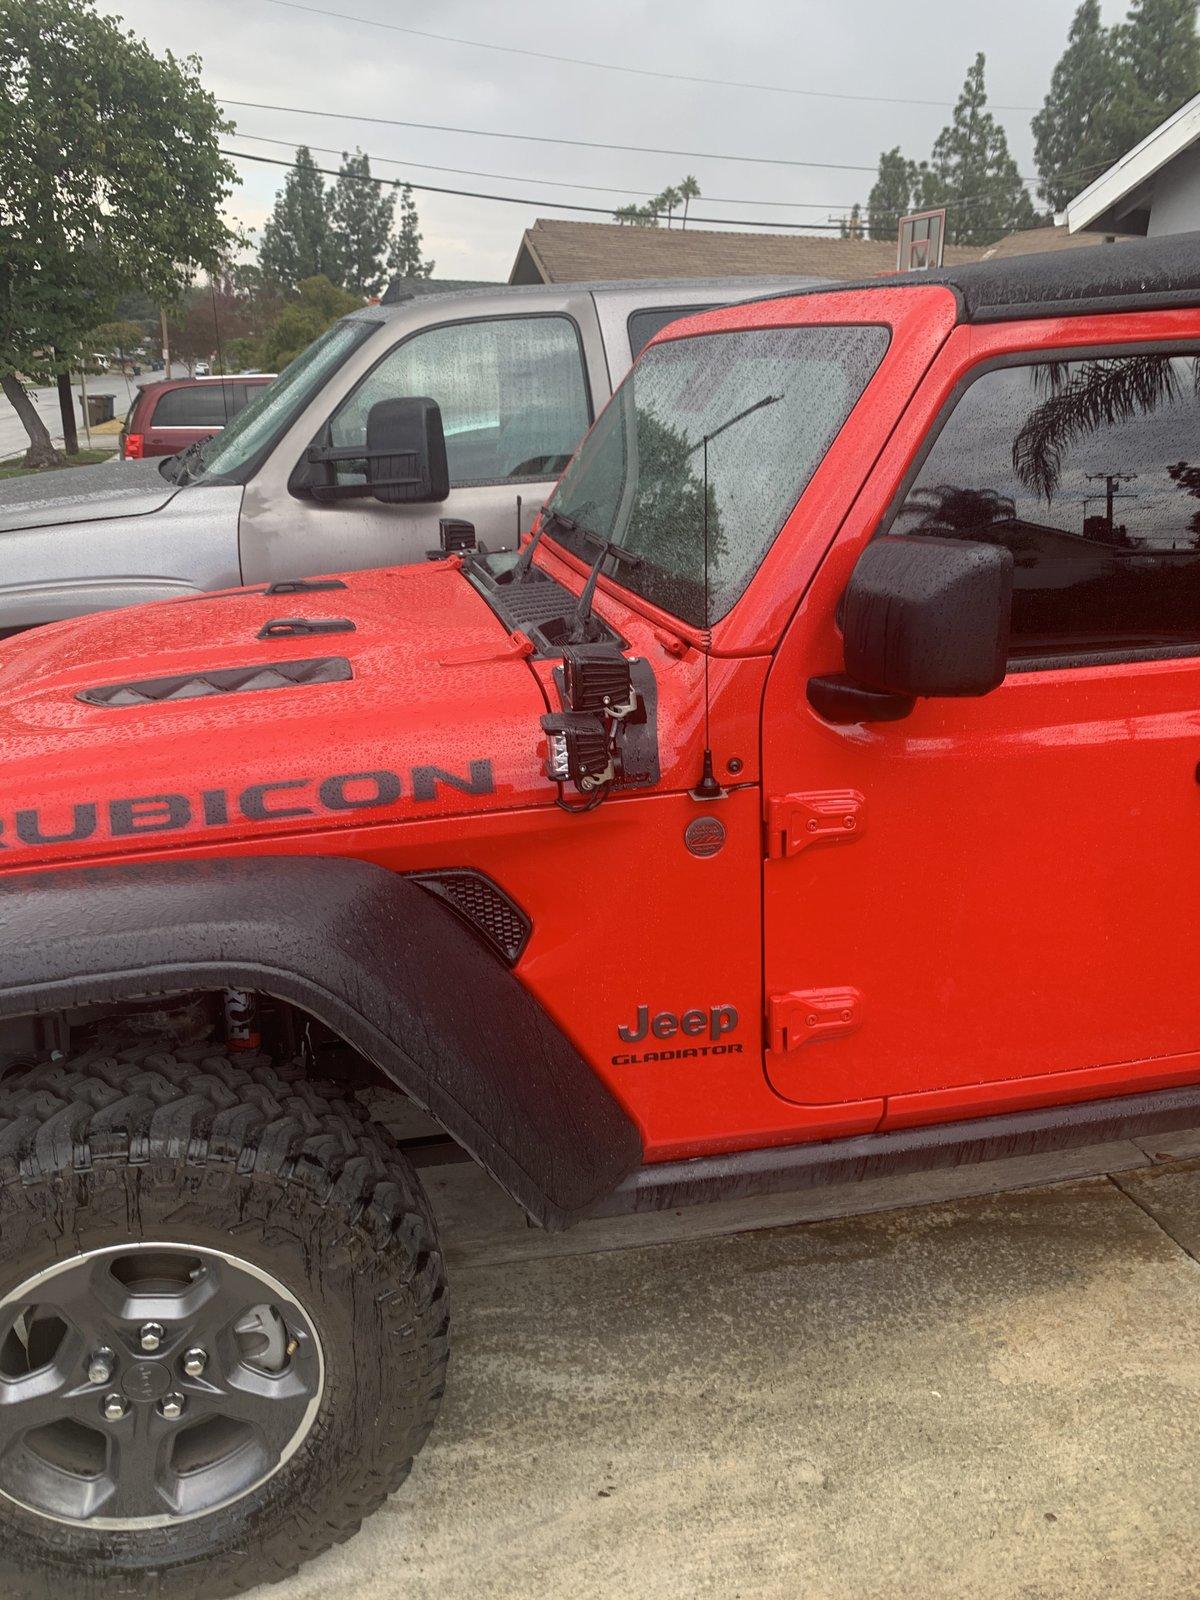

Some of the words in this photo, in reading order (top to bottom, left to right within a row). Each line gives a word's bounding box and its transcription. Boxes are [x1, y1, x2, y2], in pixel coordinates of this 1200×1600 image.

[0, 758, 494, 849] UBICON
[618, 1004, 739, 1042] Jeep
[612, 1044, 743, 1065] GLADIATOR
